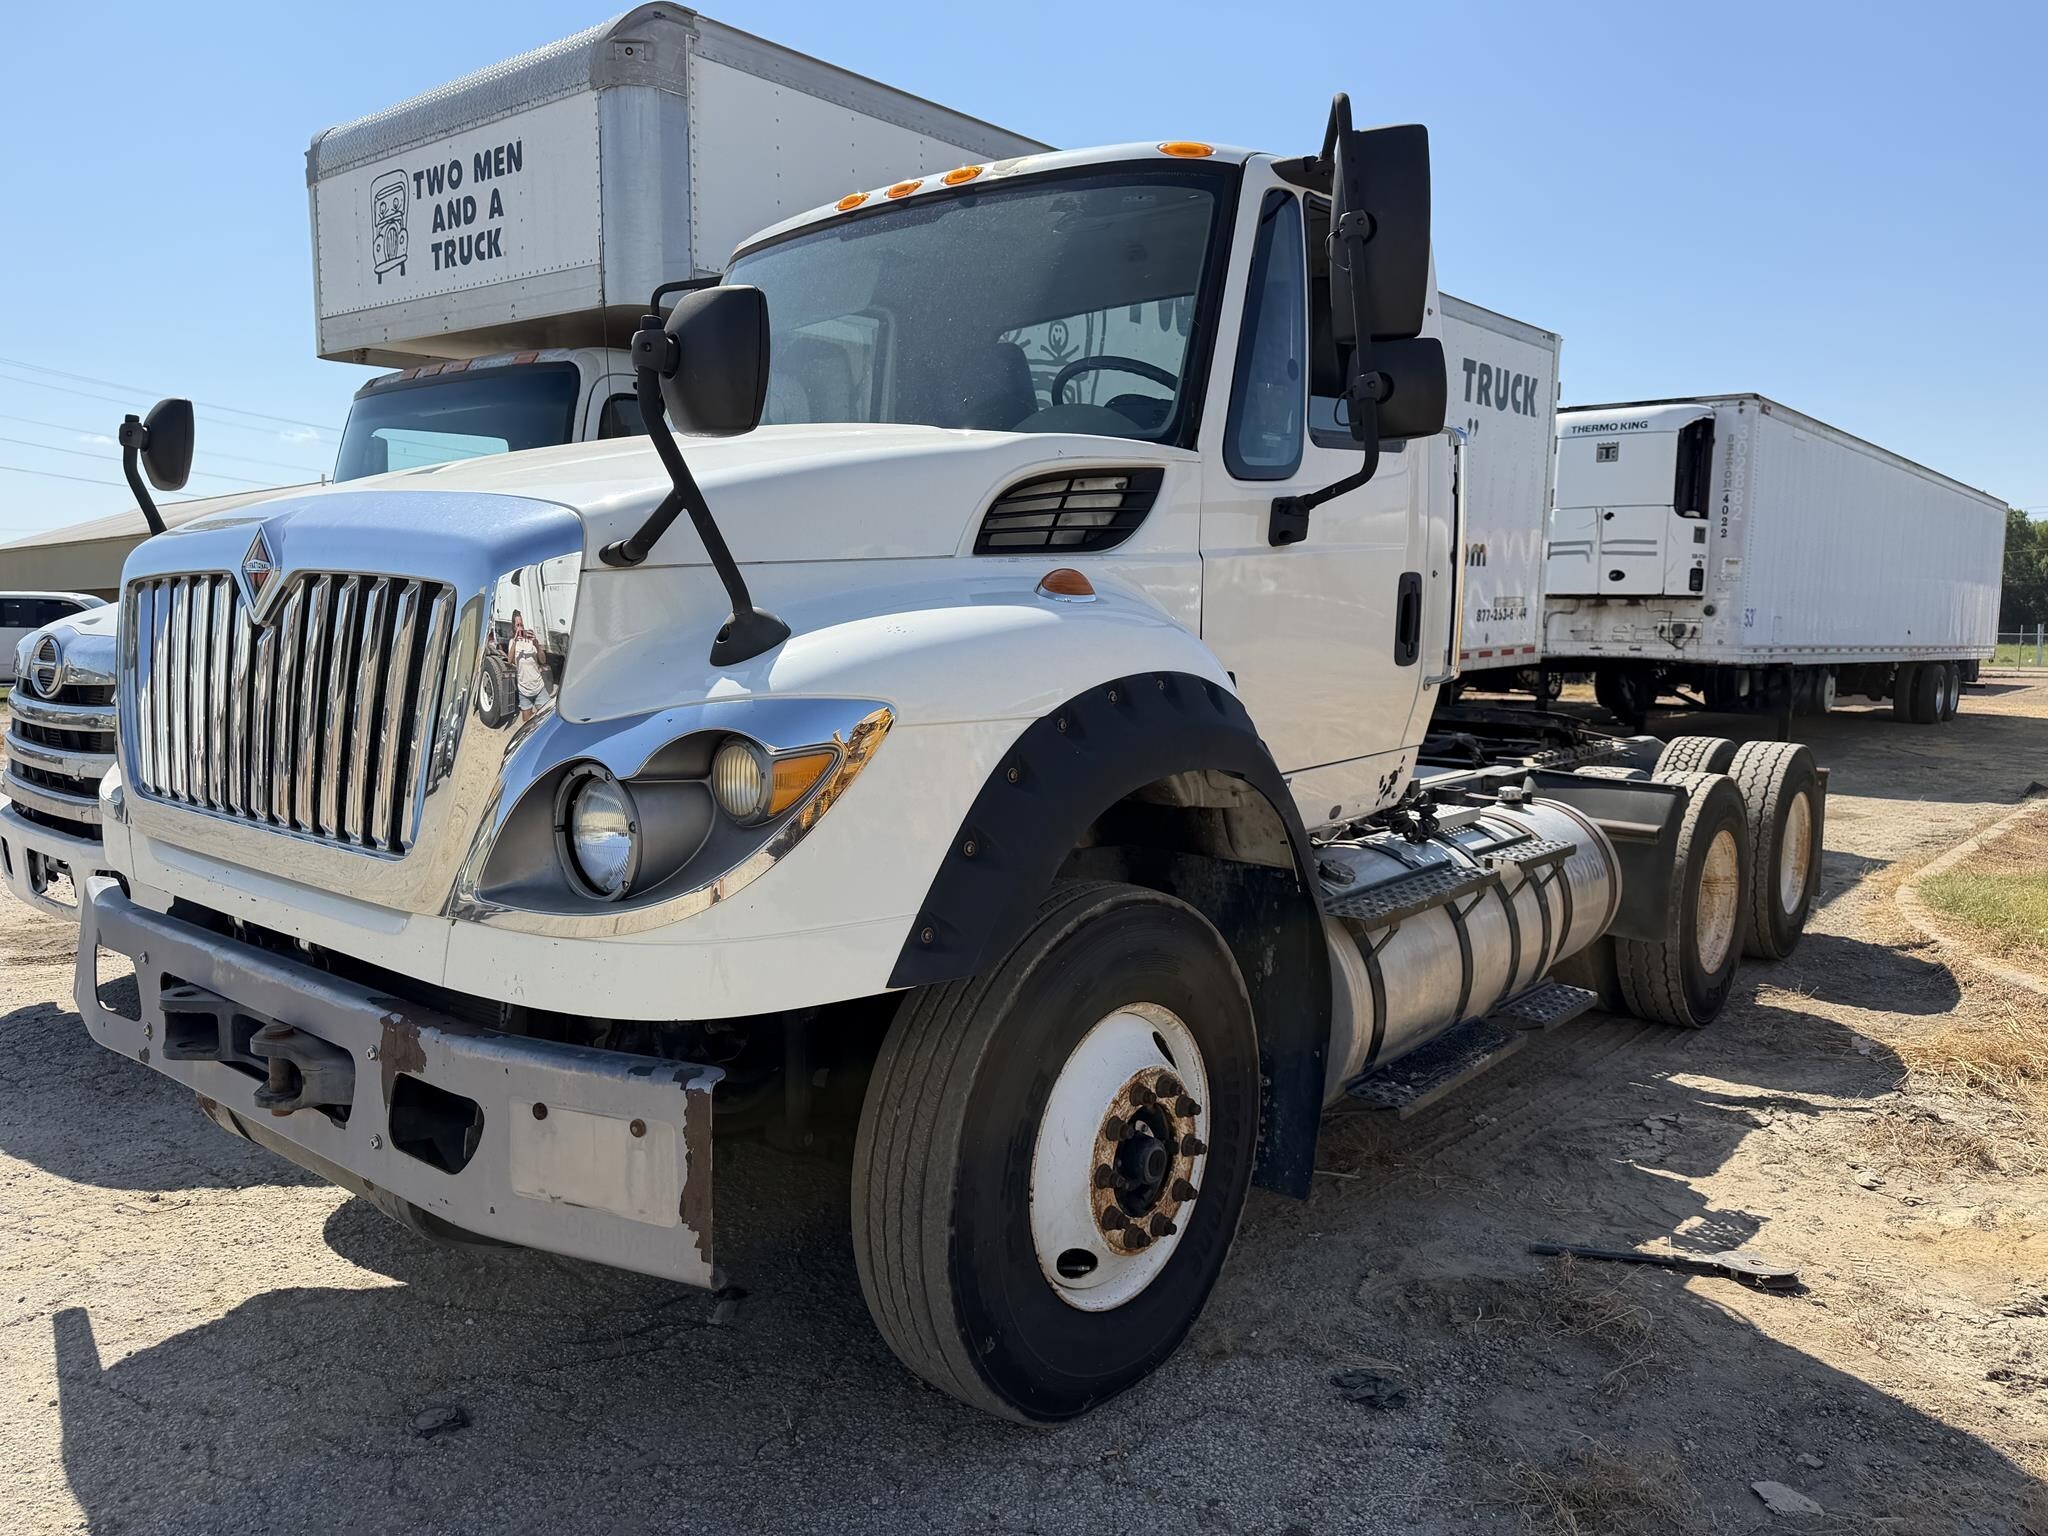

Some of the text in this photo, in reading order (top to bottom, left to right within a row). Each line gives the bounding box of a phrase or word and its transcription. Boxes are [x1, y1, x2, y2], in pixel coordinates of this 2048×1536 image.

[413, 140, 523, 200] TWO MEN
[432, 187, 505, 234] AND A
[431, 227, 503, 271] TRUCK
[1462, 357, 1539, 418] TRUCK
[1571, 420, 1648, 434] THERMO KING
